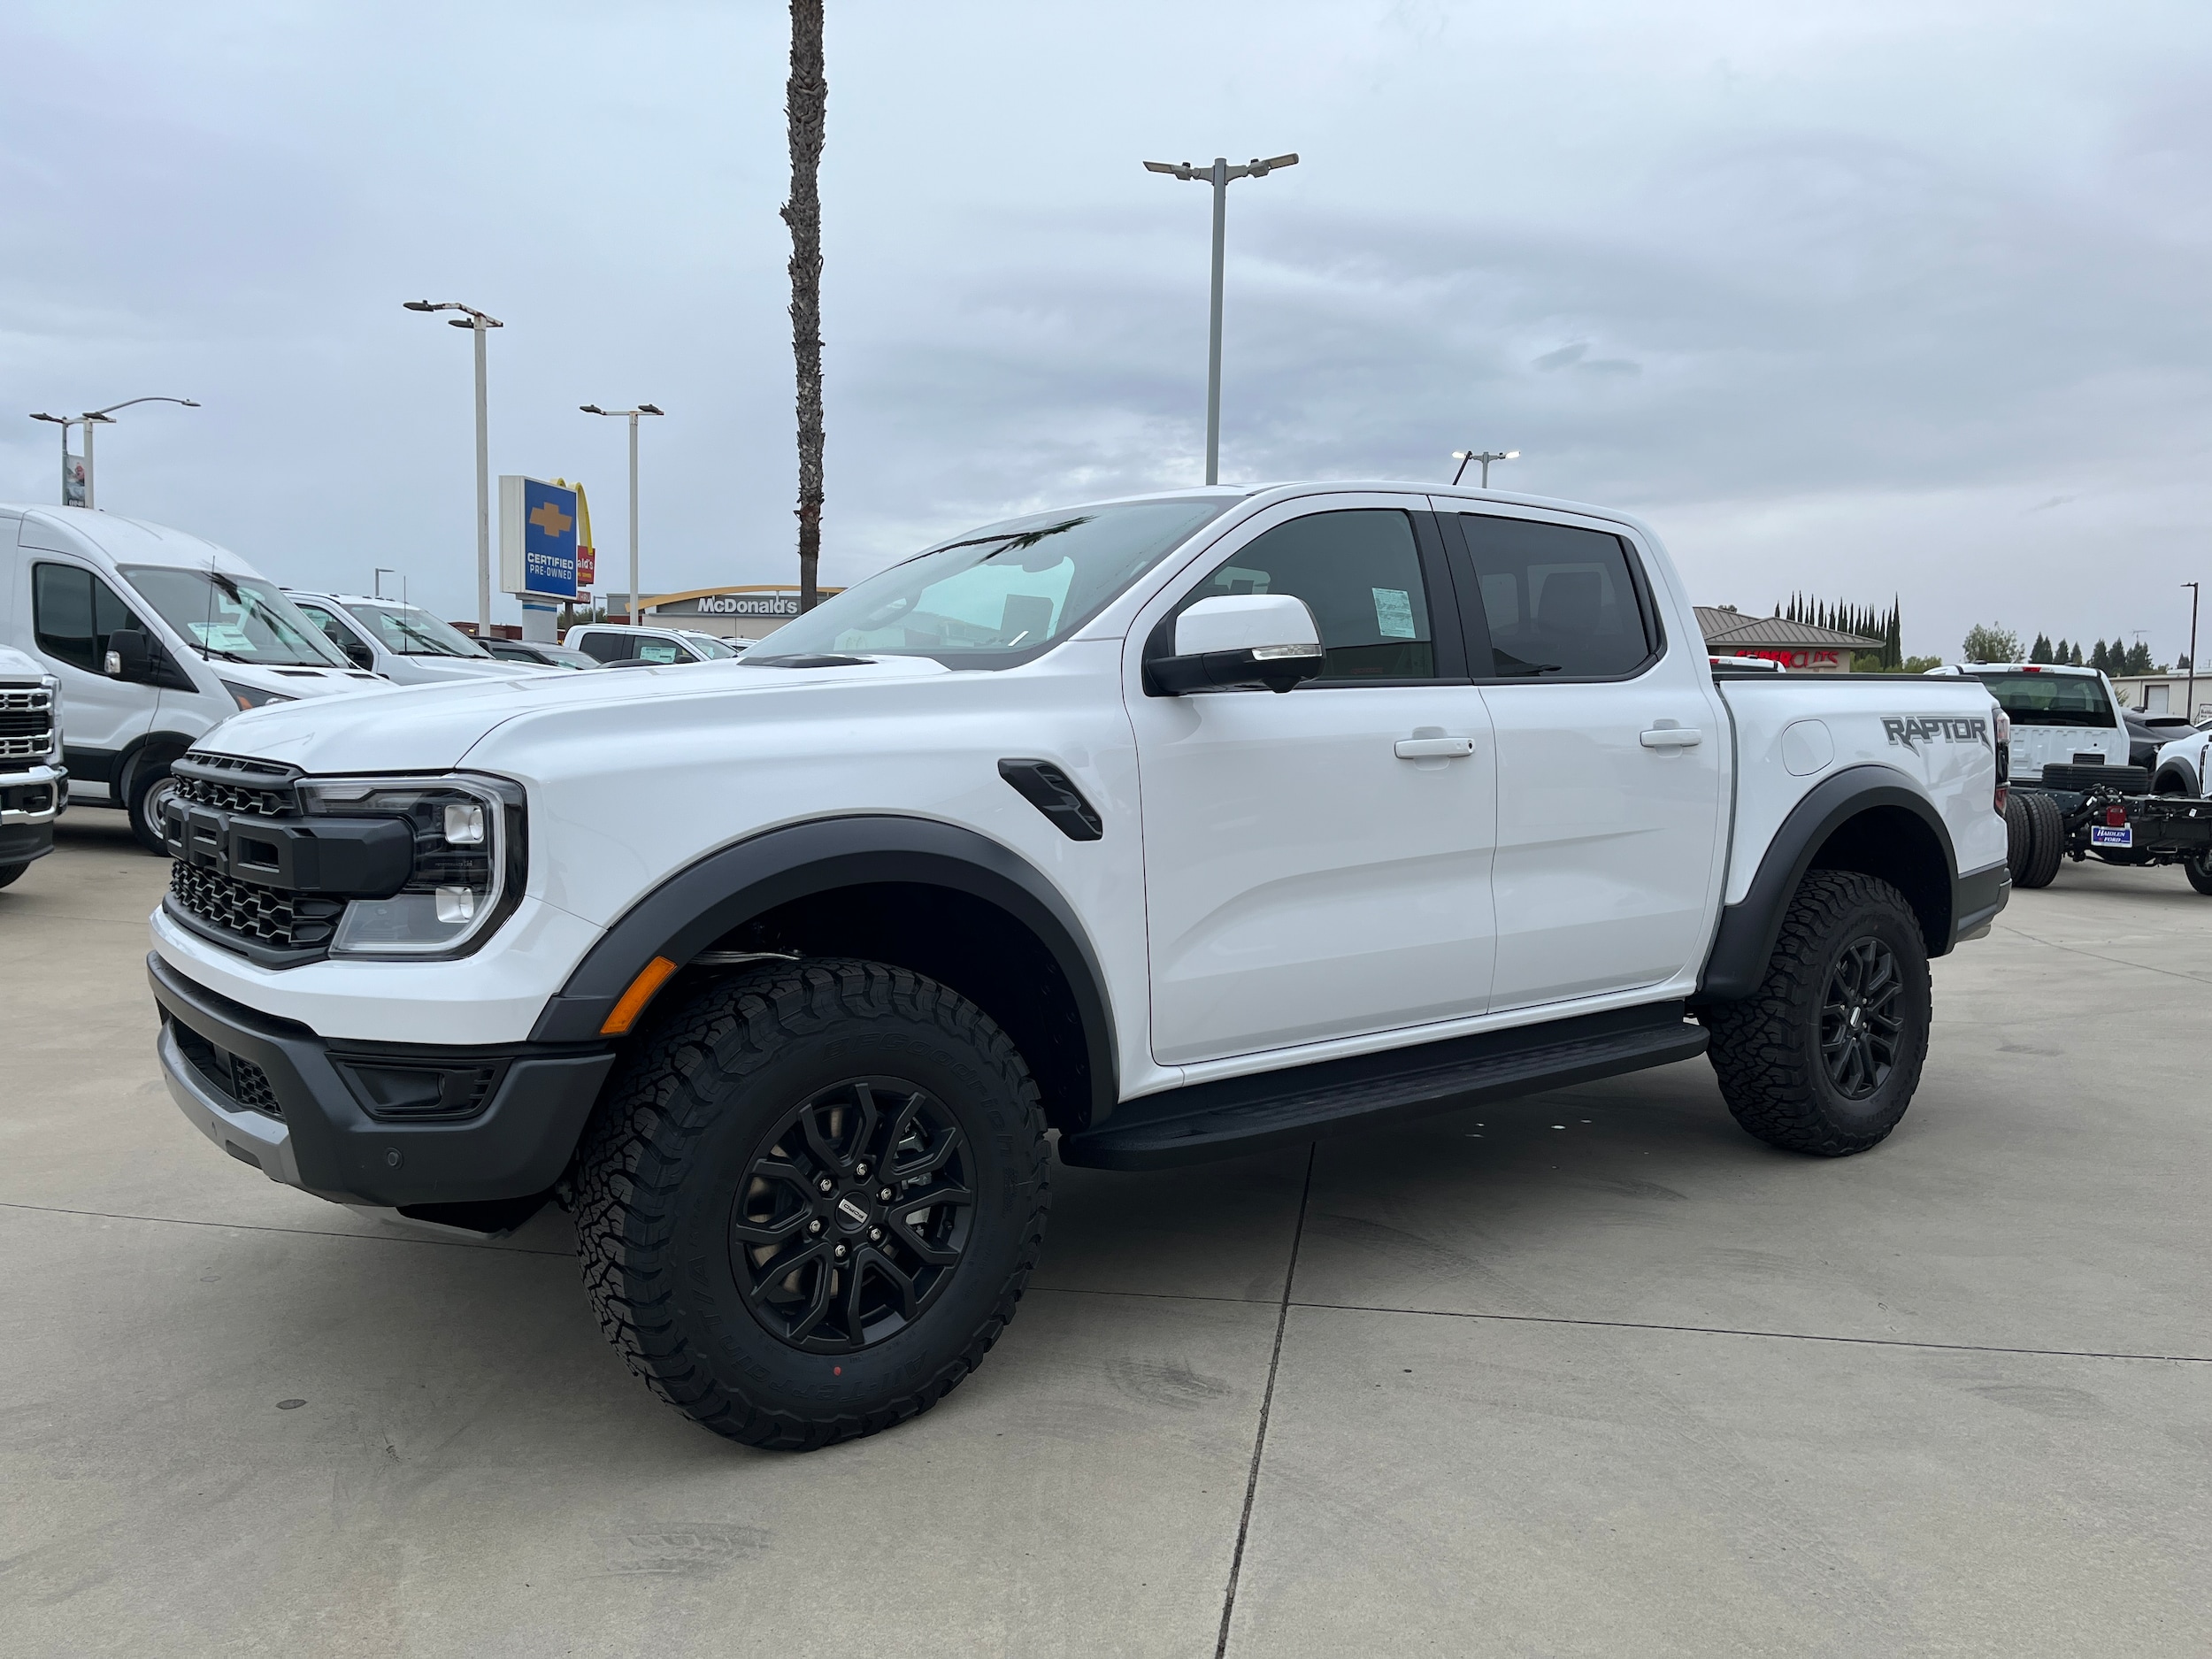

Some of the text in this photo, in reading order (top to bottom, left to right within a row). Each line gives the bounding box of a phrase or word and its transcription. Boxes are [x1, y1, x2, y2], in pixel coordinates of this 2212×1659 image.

[527, 552, 574, 571] CERTIFIED
[577, 557, 594, 570] ald's
[529, 564, 572, 580] PRE-OWNED
[697, 597, 798, 614] McDonald's
[1879, 716, 1993, 757] RAPTOR
[820, 1032, 1013, 1158] BFGoodrich
[842, 1203, 864, 1219] FORD
